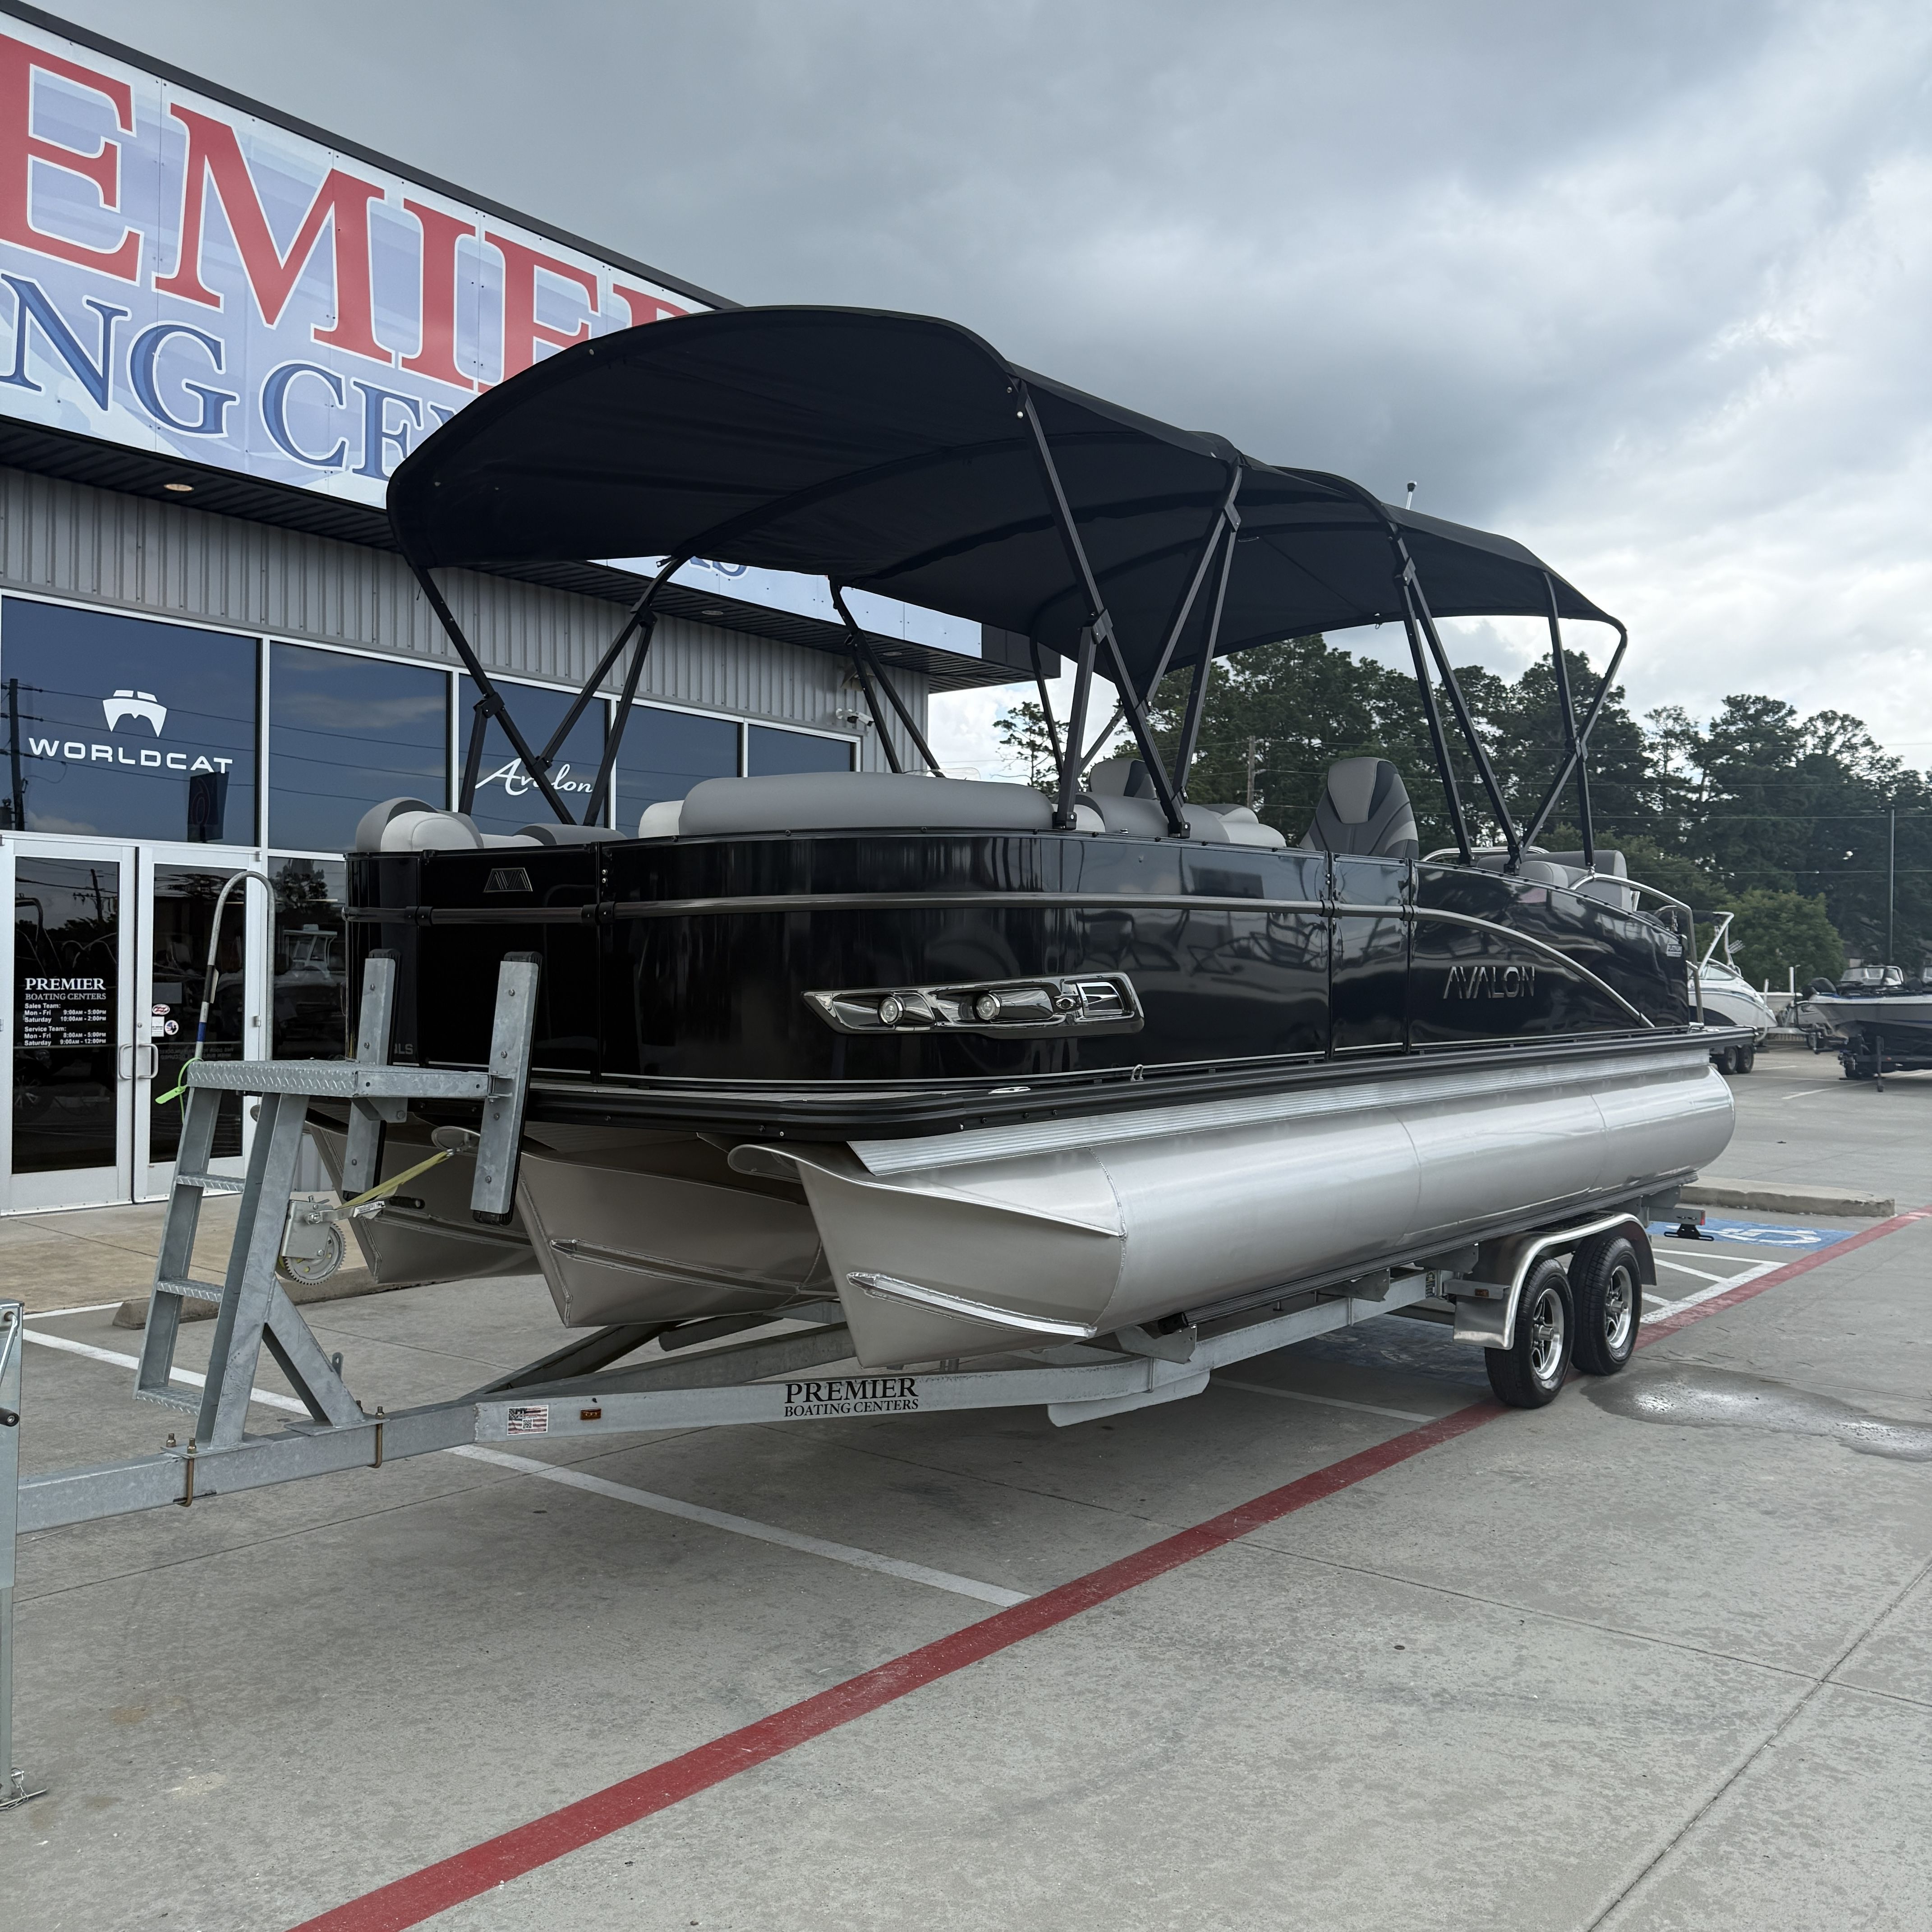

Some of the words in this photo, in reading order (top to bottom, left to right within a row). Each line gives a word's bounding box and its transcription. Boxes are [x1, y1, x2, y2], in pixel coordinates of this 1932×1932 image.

[0, 34, 695, 394] EMIE
[262, 363, 456, 482] CE
[28, 737, 233, 774] WORLDCAT
[25, 978, 106, 990] PREMIER
[1443, 966, 1535, 999] AVALON
[785, 1377, 919, 1403] PREMIER
[784, 1403, 851, 1417] BOATING
[854, 1399, 919, 1413] CENTERS
